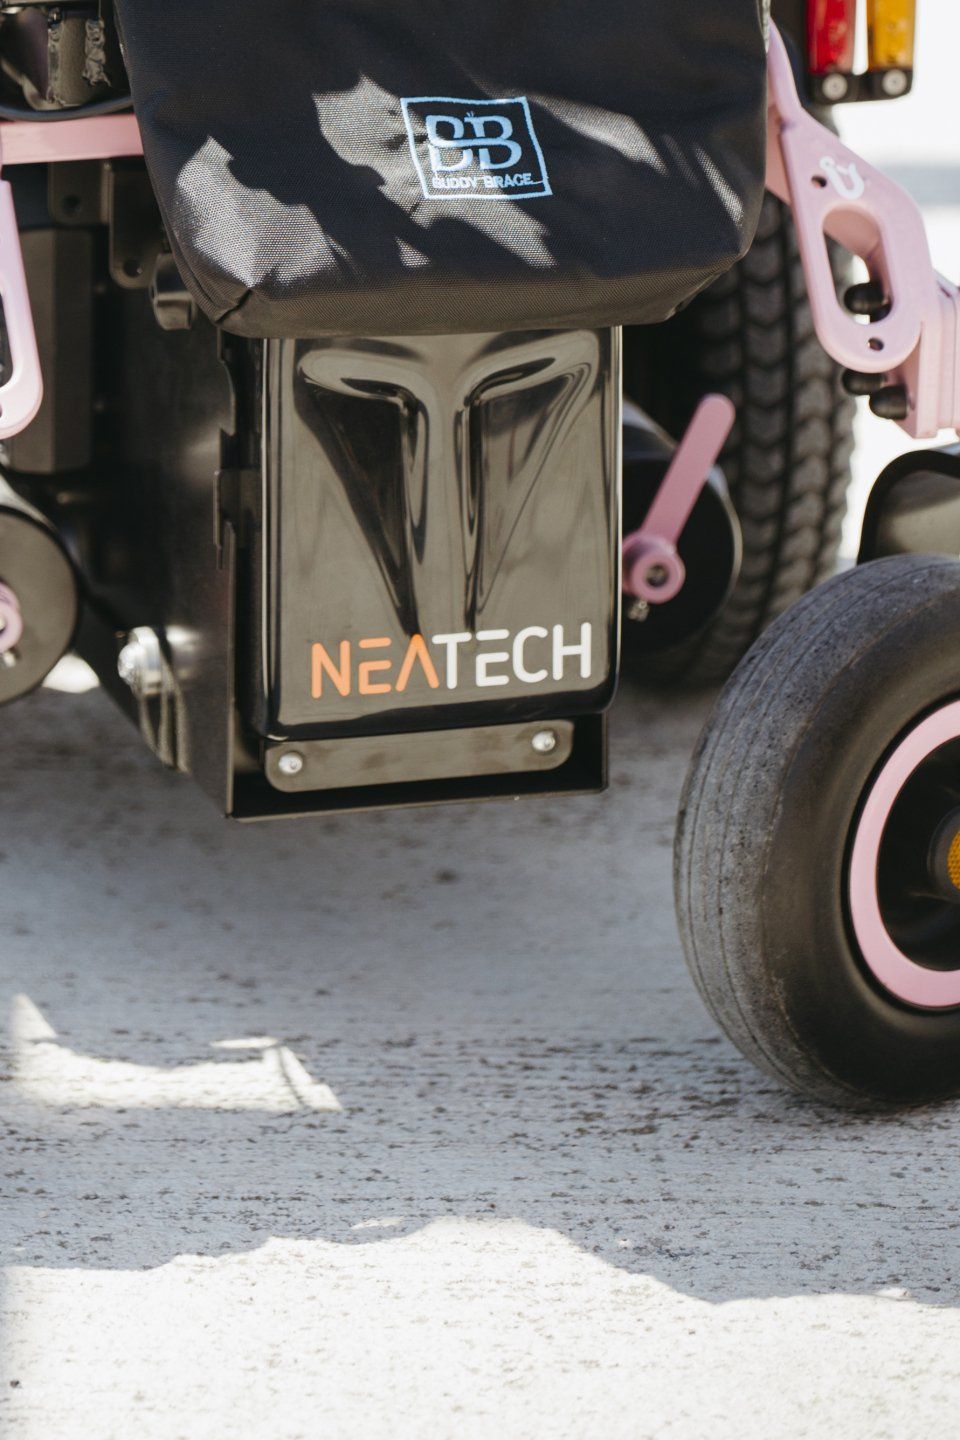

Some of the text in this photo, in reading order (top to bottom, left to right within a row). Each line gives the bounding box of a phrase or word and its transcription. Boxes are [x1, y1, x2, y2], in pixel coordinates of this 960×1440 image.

[431, 172, 533, 189] BUDDY BRACE
[311, 622, 592, 699] NEATECH
